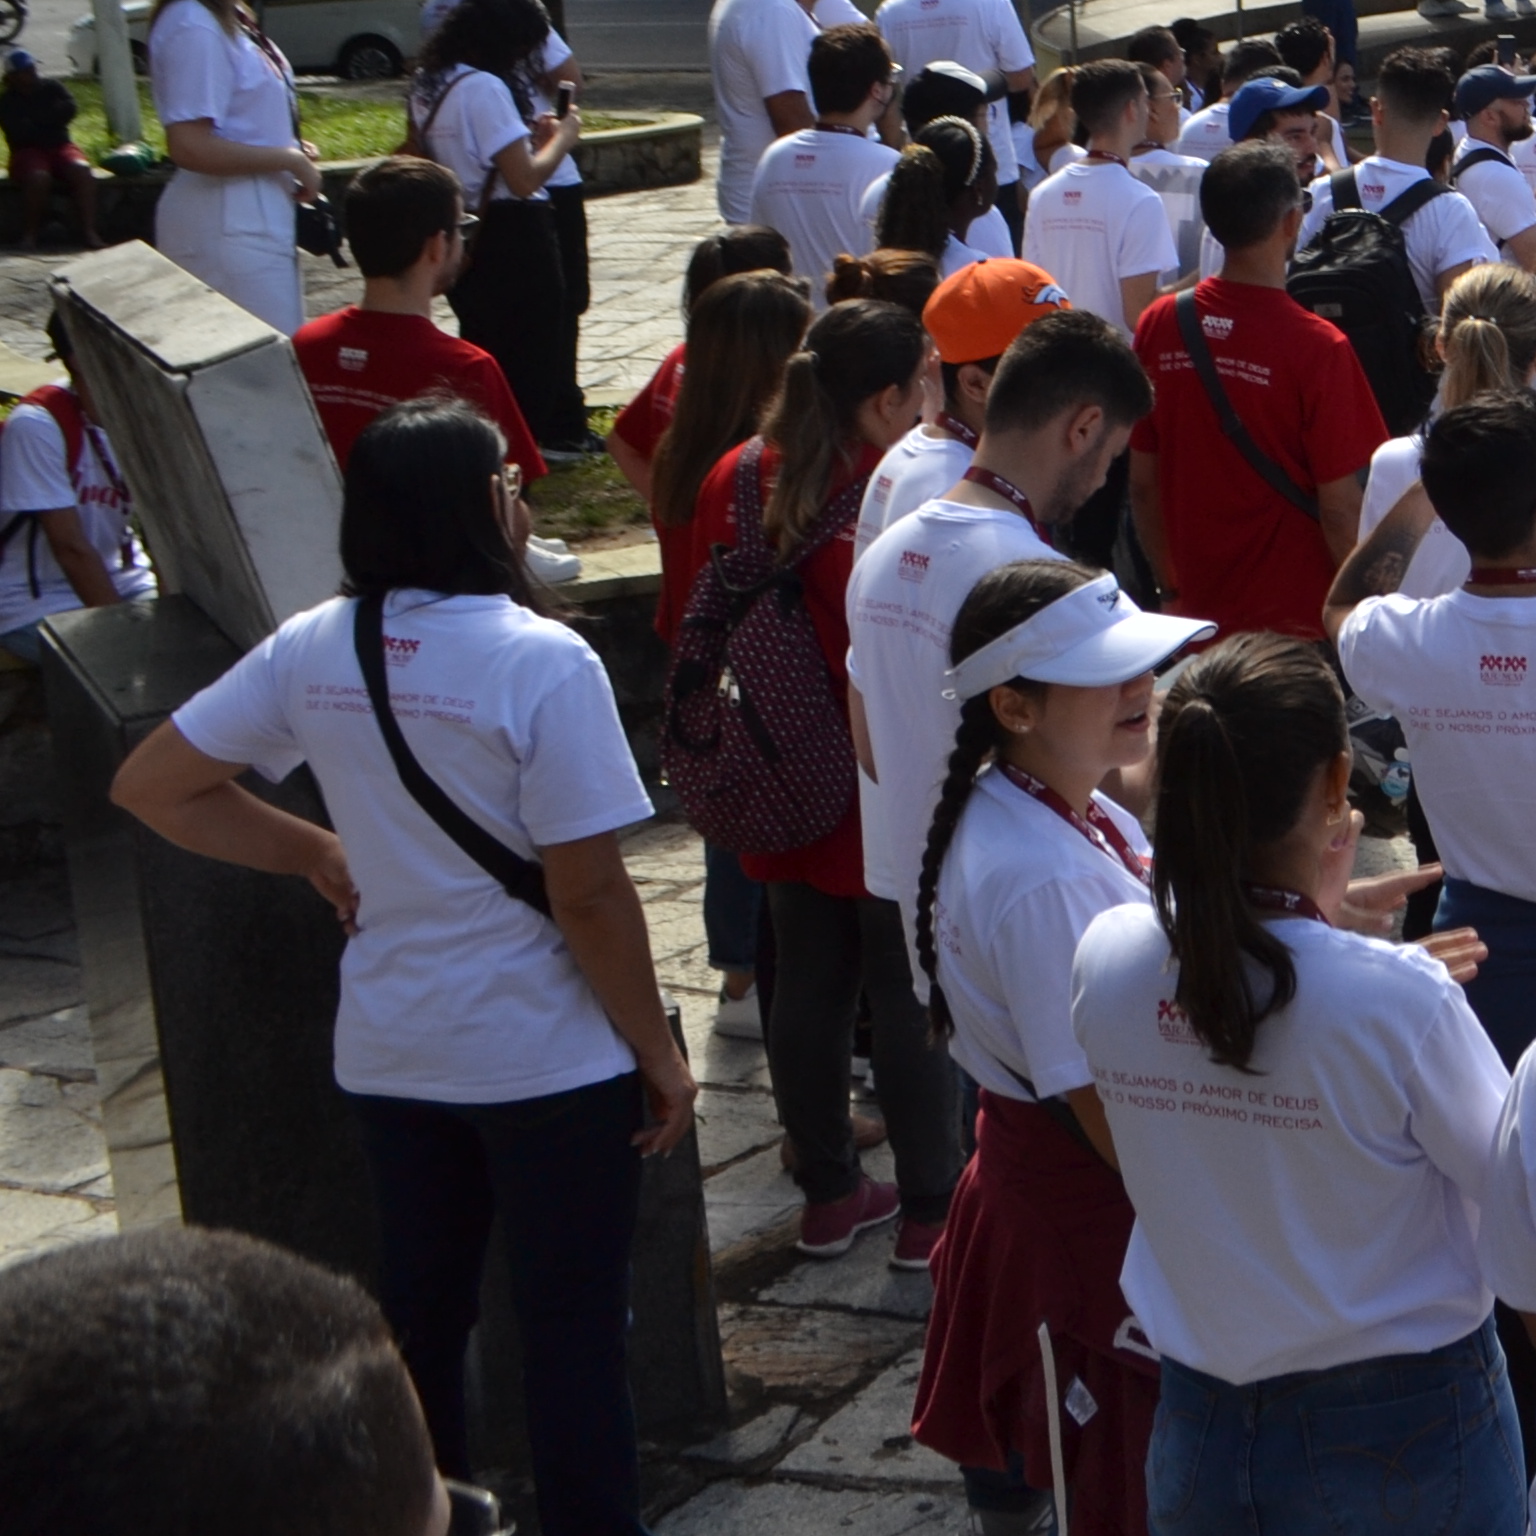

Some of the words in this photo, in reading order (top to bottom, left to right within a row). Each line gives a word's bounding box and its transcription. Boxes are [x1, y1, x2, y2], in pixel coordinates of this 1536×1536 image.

[325, 685, 369, 698] SEJAMO
[422, 693, 440, 705] DE
[442, 695, 475, 710] DEUS
[332, 702, 373, 715] NOSSO
[1408, 706, 1430, 718] QUE
[1436, 708, 1493, 721] SEJAMOS
[1497, 710, 1507, 721] O
[1409, 719, 1430, 731] QUE
[1435, 721, 1445, 732] O
[1449, 722, 1491, 734] NOSSO
[1112, 1071, 1178, 1093] SEJAMOS
[1183, 1082, 1194, 1095] O
[1200, 1084, 1243, 1104] AMOR
[1248, 1091, 1268, 1106] DE
[1273, 1094, 1320, 1113] DEUS
[1128, 1094, 1177, 1113] NOSSO
[1183, 1099, 1248, 1123] PRÓXIMO
